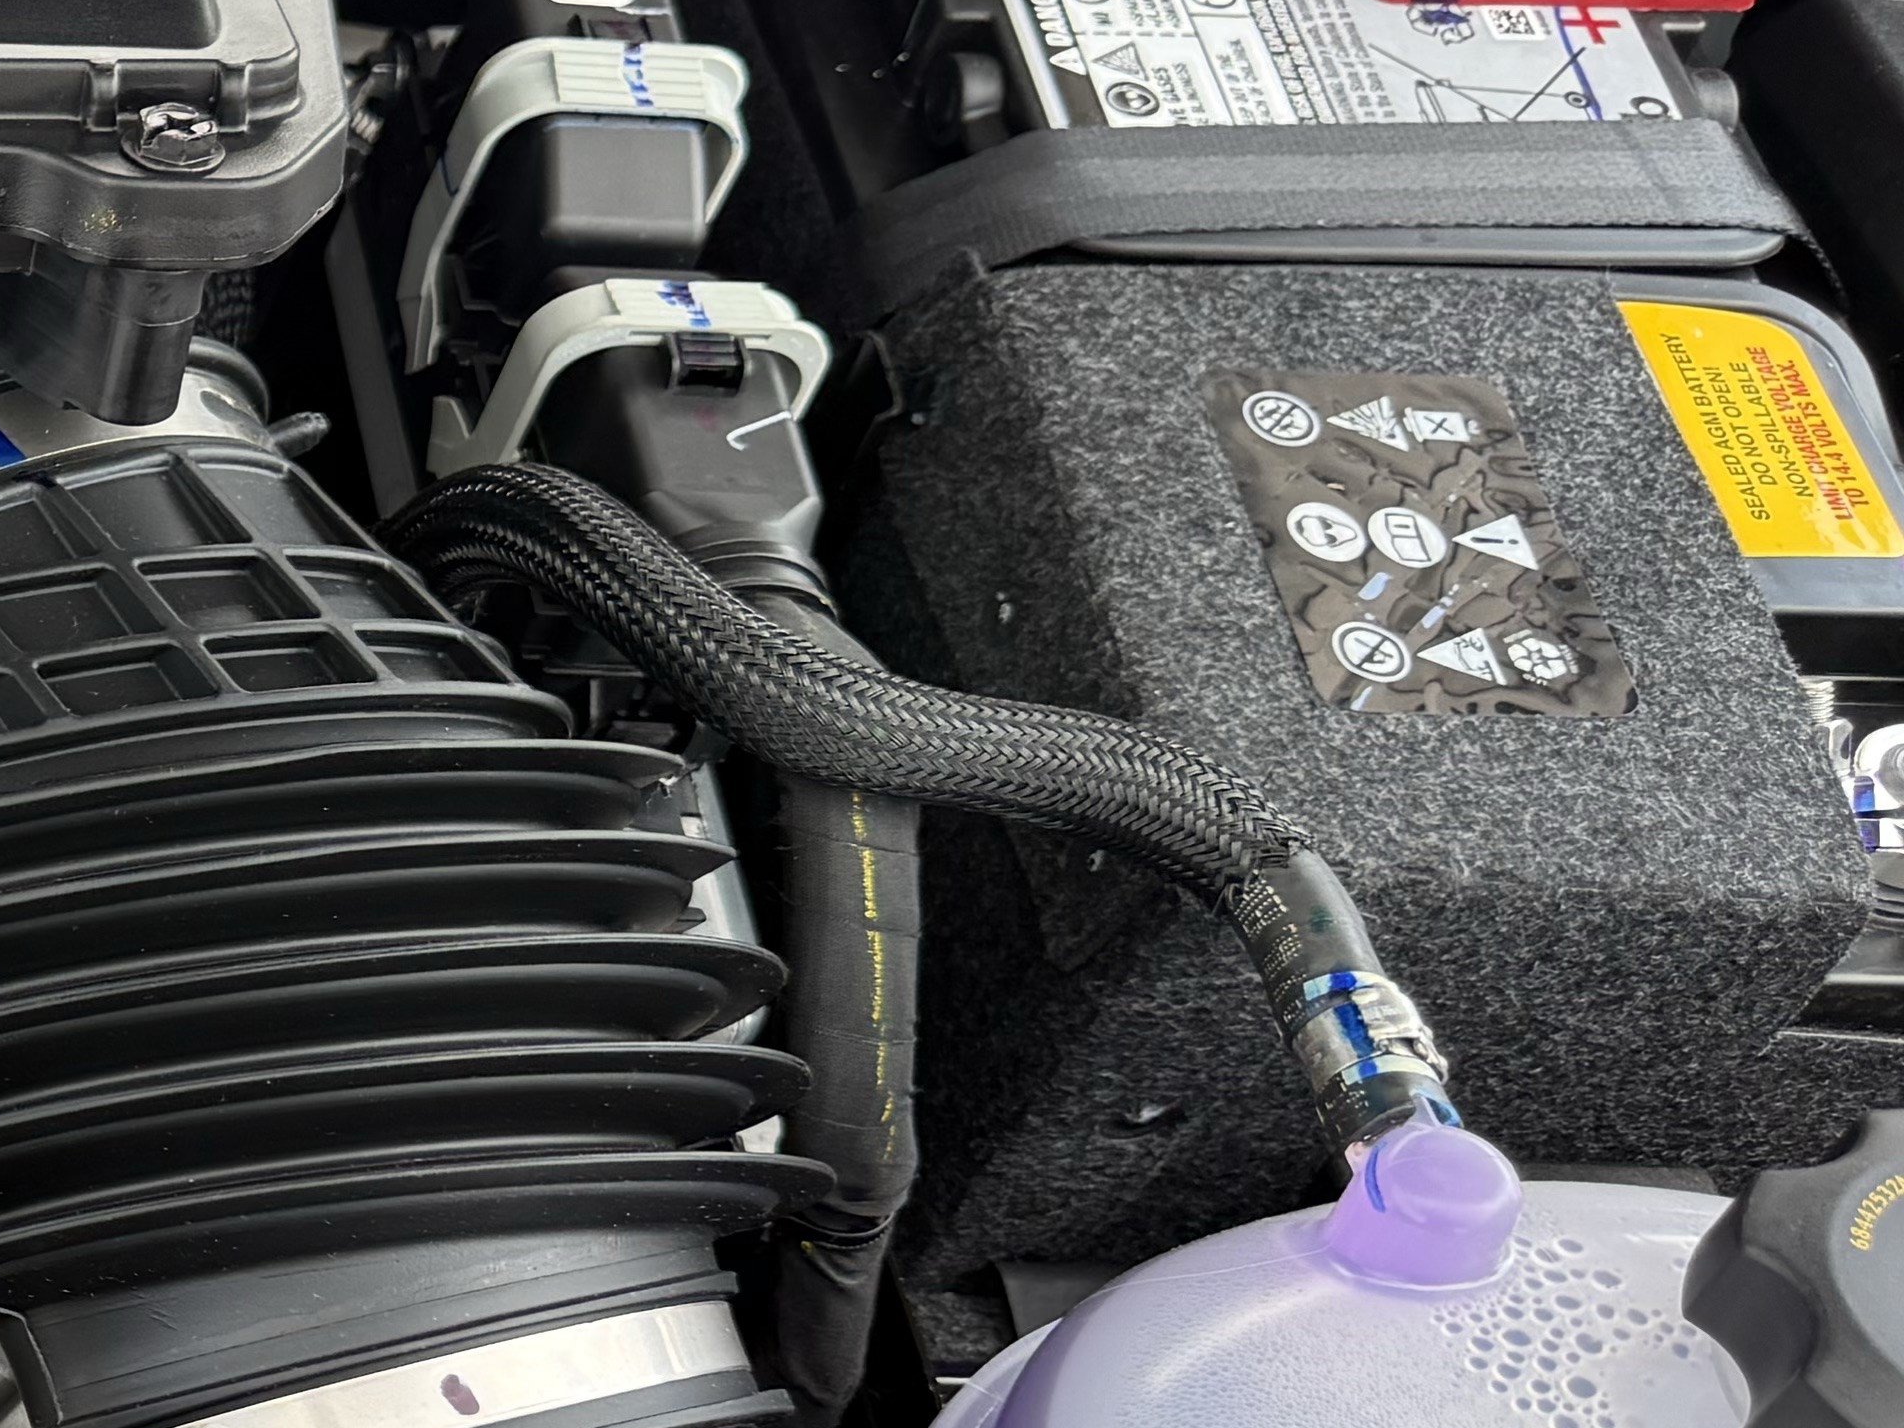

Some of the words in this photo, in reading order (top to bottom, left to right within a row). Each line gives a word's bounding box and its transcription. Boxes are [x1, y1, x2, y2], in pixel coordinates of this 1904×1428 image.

[1660, 332, 1713, 407] BATTERY
[1746, 346, 1795, 411] VOLTAGE
[1776, 360, 1810, 396] MAX.
[1702, 365, 1743, 418] OPEN!
[1699, 411, 1734, 450] AGM
[1729, 361, 1813, 497] NON-SPILLABLE
[1729, 422, 1762, 457] NOT
[1798, 401, 1837, 446] VOLTS
[1782, 415, 1829, 475] CHARGE
[1721, 454, 1770, 520] SEALED
[1750, 462, 1777, 485] DO
[1824, 452, 1856, 482] 14.4
[1816, 479, 1853, 519] LIMIT
[1842, 487, 1869, 506] TO
